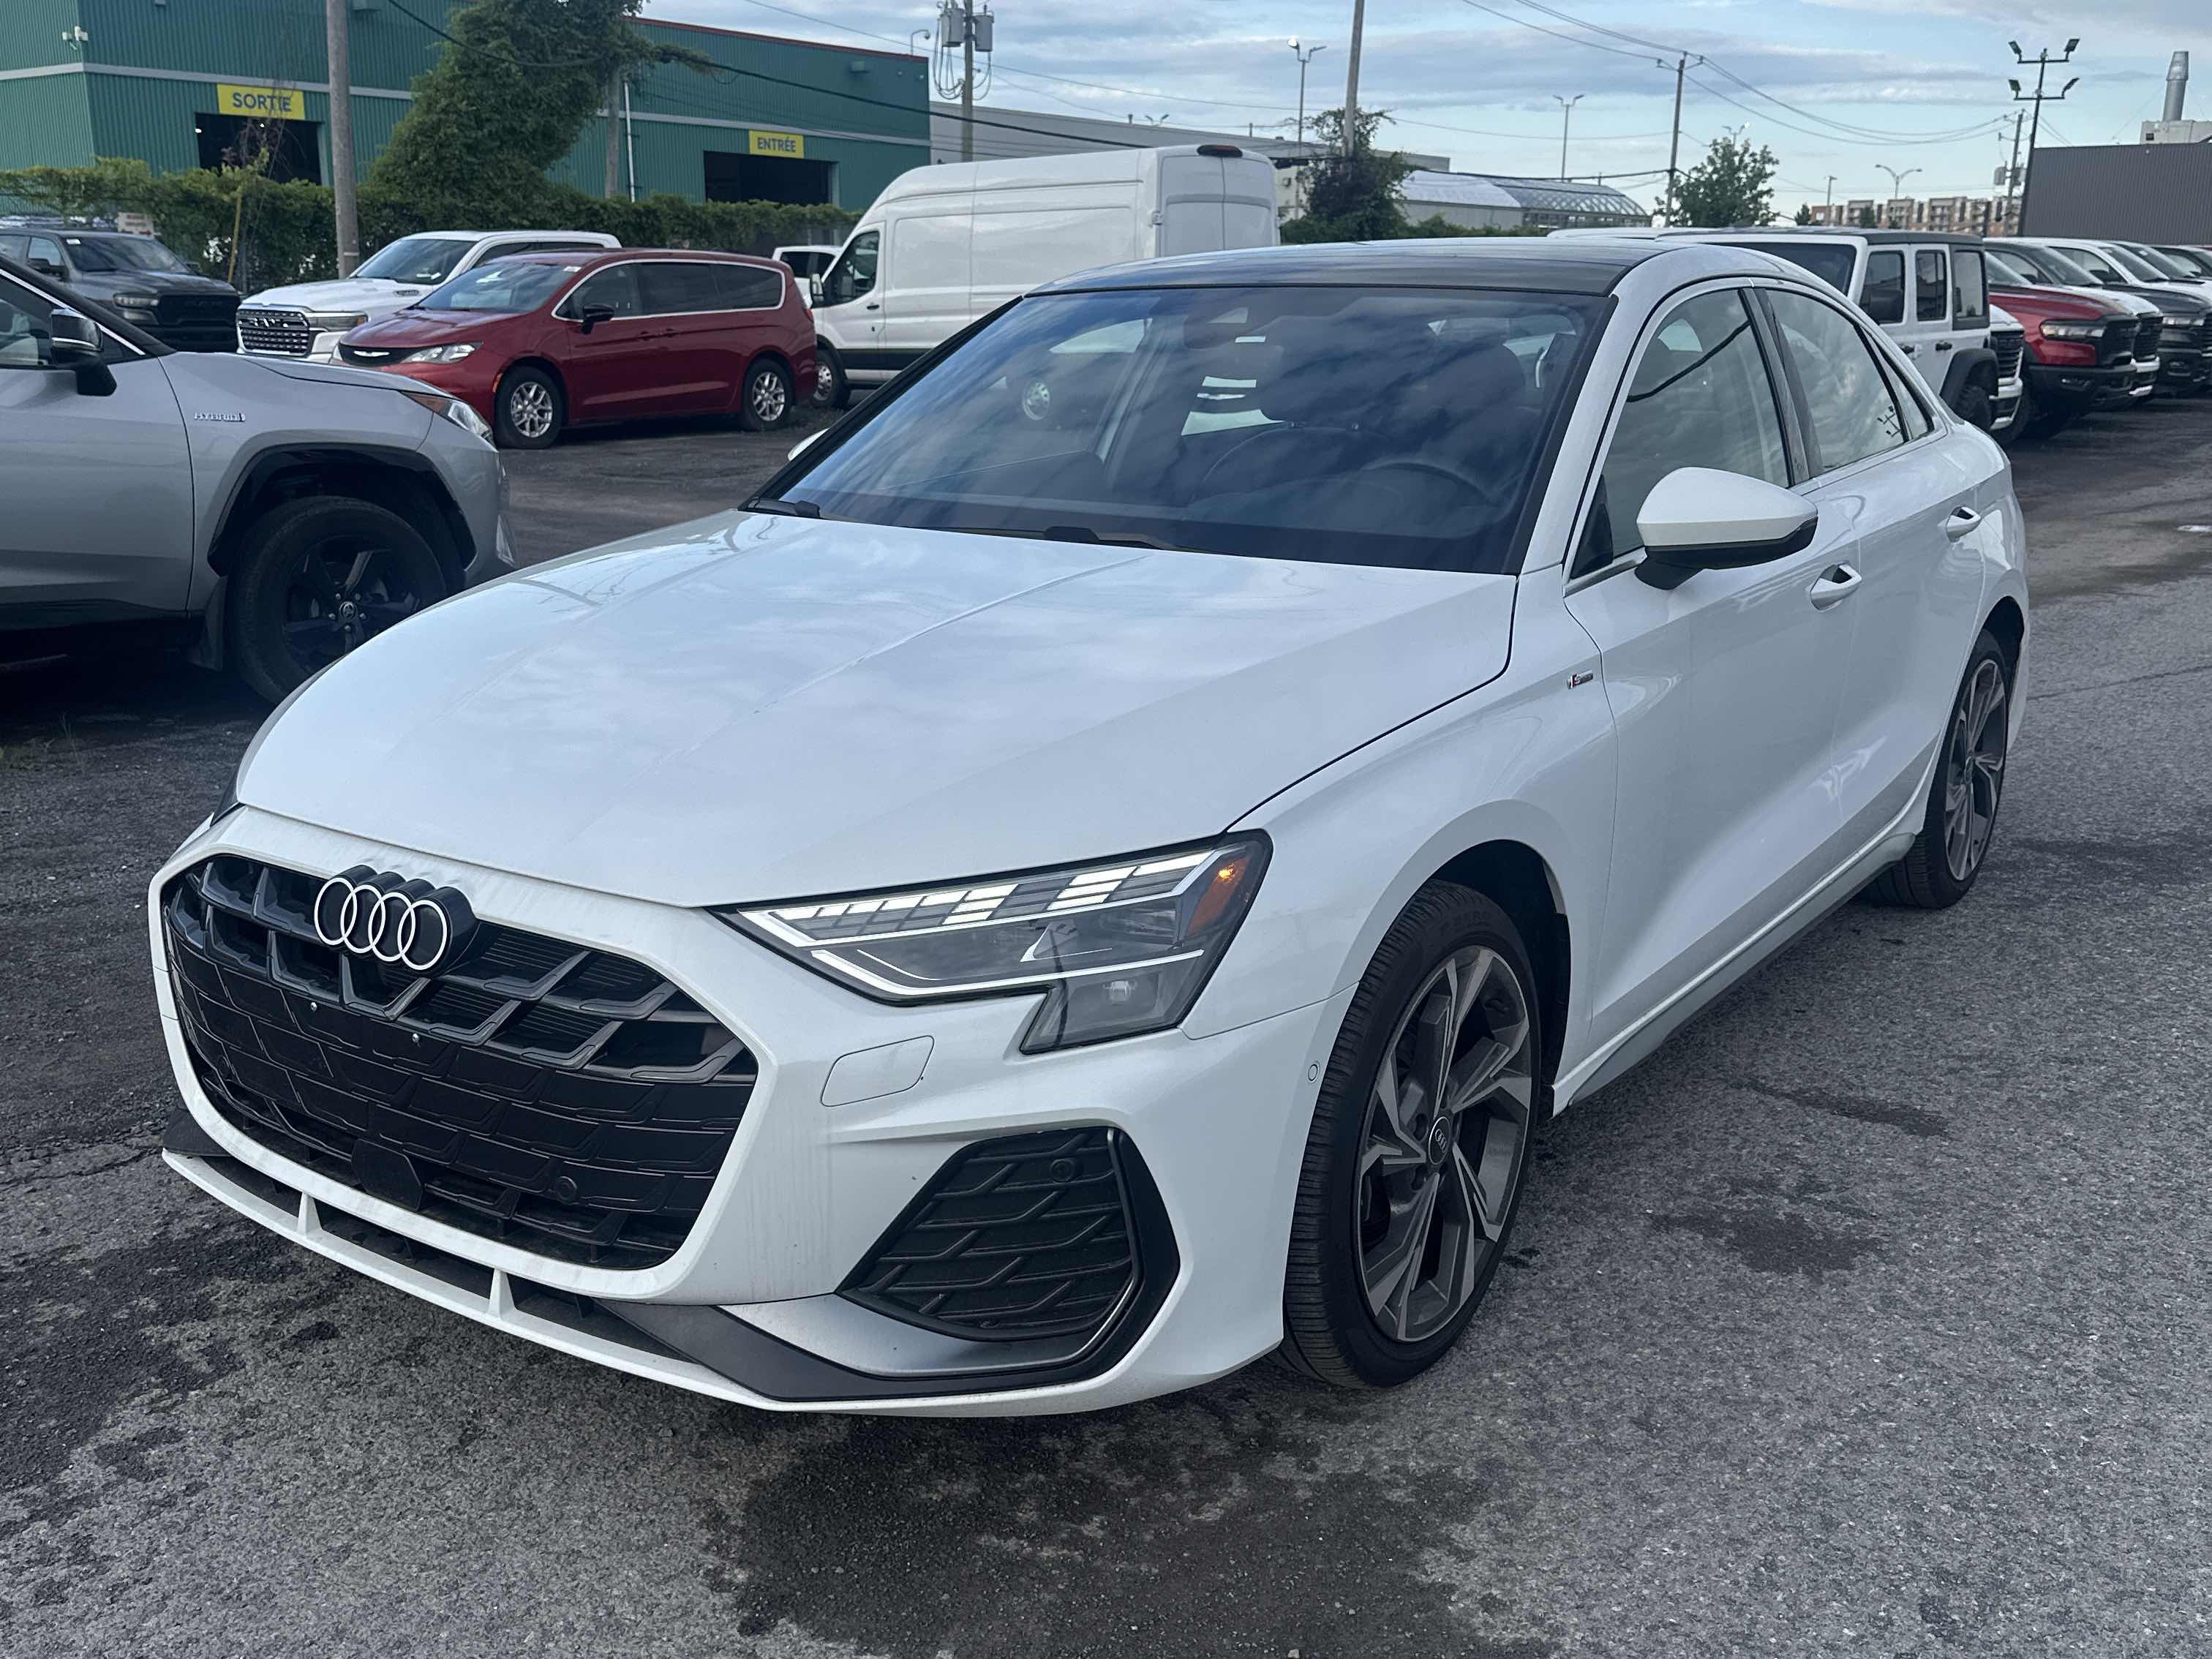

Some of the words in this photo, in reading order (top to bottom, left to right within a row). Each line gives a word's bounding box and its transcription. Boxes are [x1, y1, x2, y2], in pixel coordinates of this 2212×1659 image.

[233, 92, 292, 112] SORTIE
[757, 136, 797, 153] ENTRÉE
[194, 412, 246, 422] HYBRID
